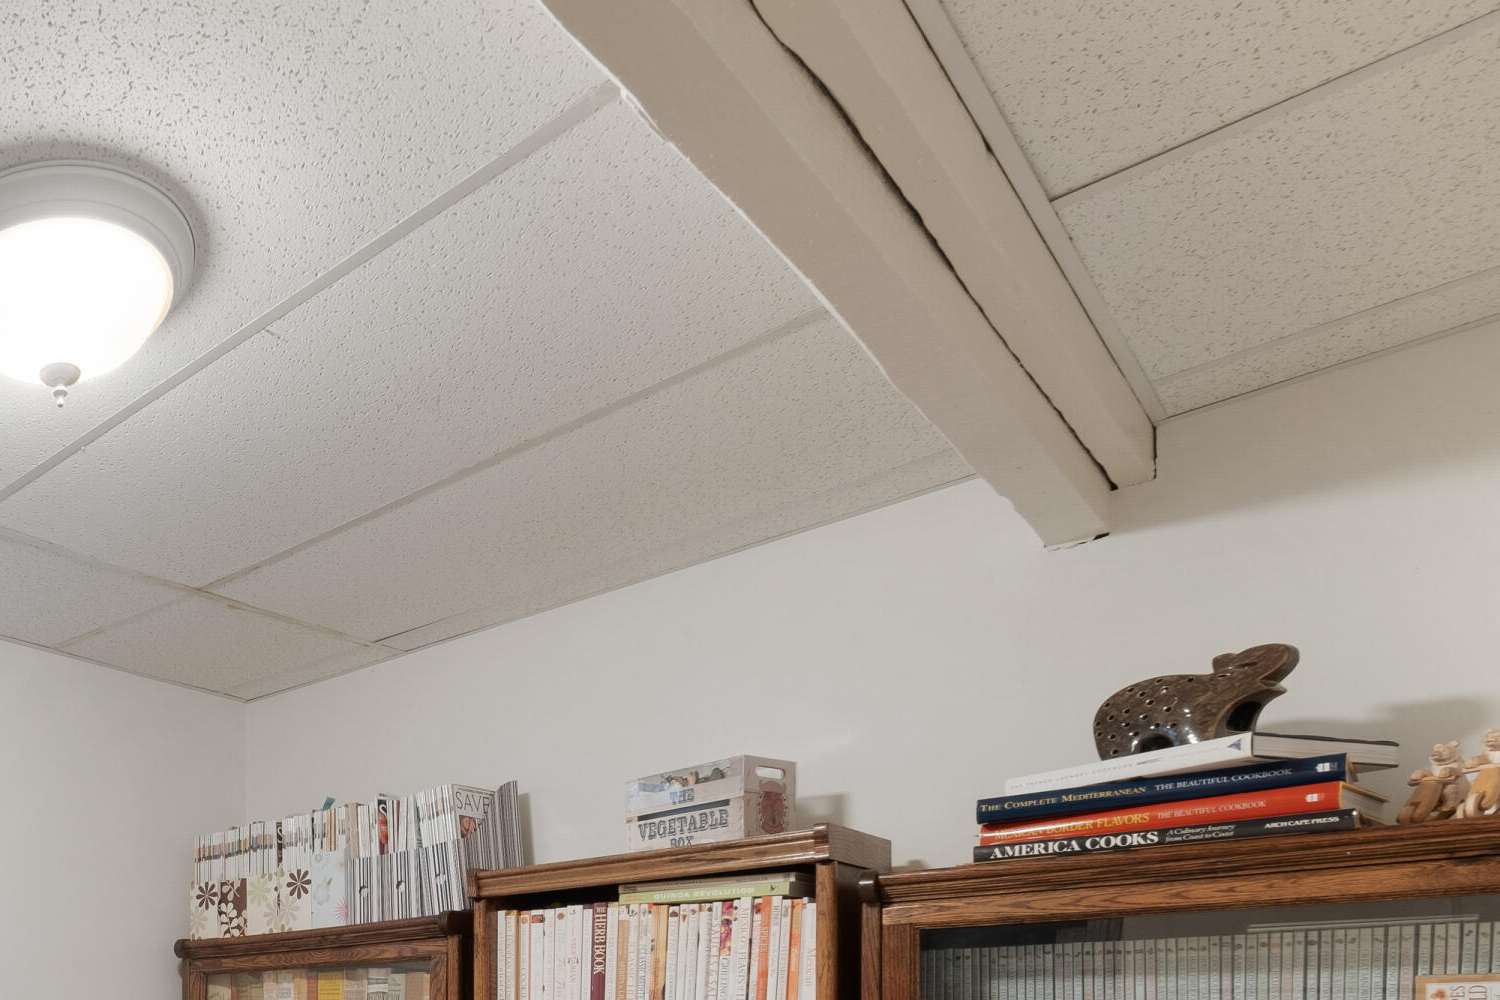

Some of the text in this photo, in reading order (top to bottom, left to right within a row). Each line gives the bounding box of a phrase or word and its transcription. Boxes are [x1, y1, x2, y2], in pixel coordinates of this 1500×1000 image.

[670, 789, 694, 805] THE
[980, 804, 1000, 812] THE
[1005, 797, 1058, 810] COMPLETE
[1062, 787, 1147, 802] MEDITERRANEAN
[1176, 777, 1229, 788] BEAUTIFUL
[1230, 768, 1292, 781] COOKBOOK
[638, 809, 729, 841] VEGETABLE
[1097, 813, 1149, 827] FLAVORS
[1175, 807, 1217, 817] BEAUTIFUL
[1219, 800, 1266, 812] COOKBOOK
[1312, 816, 1339, 824] PRESS
[989, 832, 1159, 858] AMERICA COOKS
[593, 914, 606, 974] HERB BOOK
